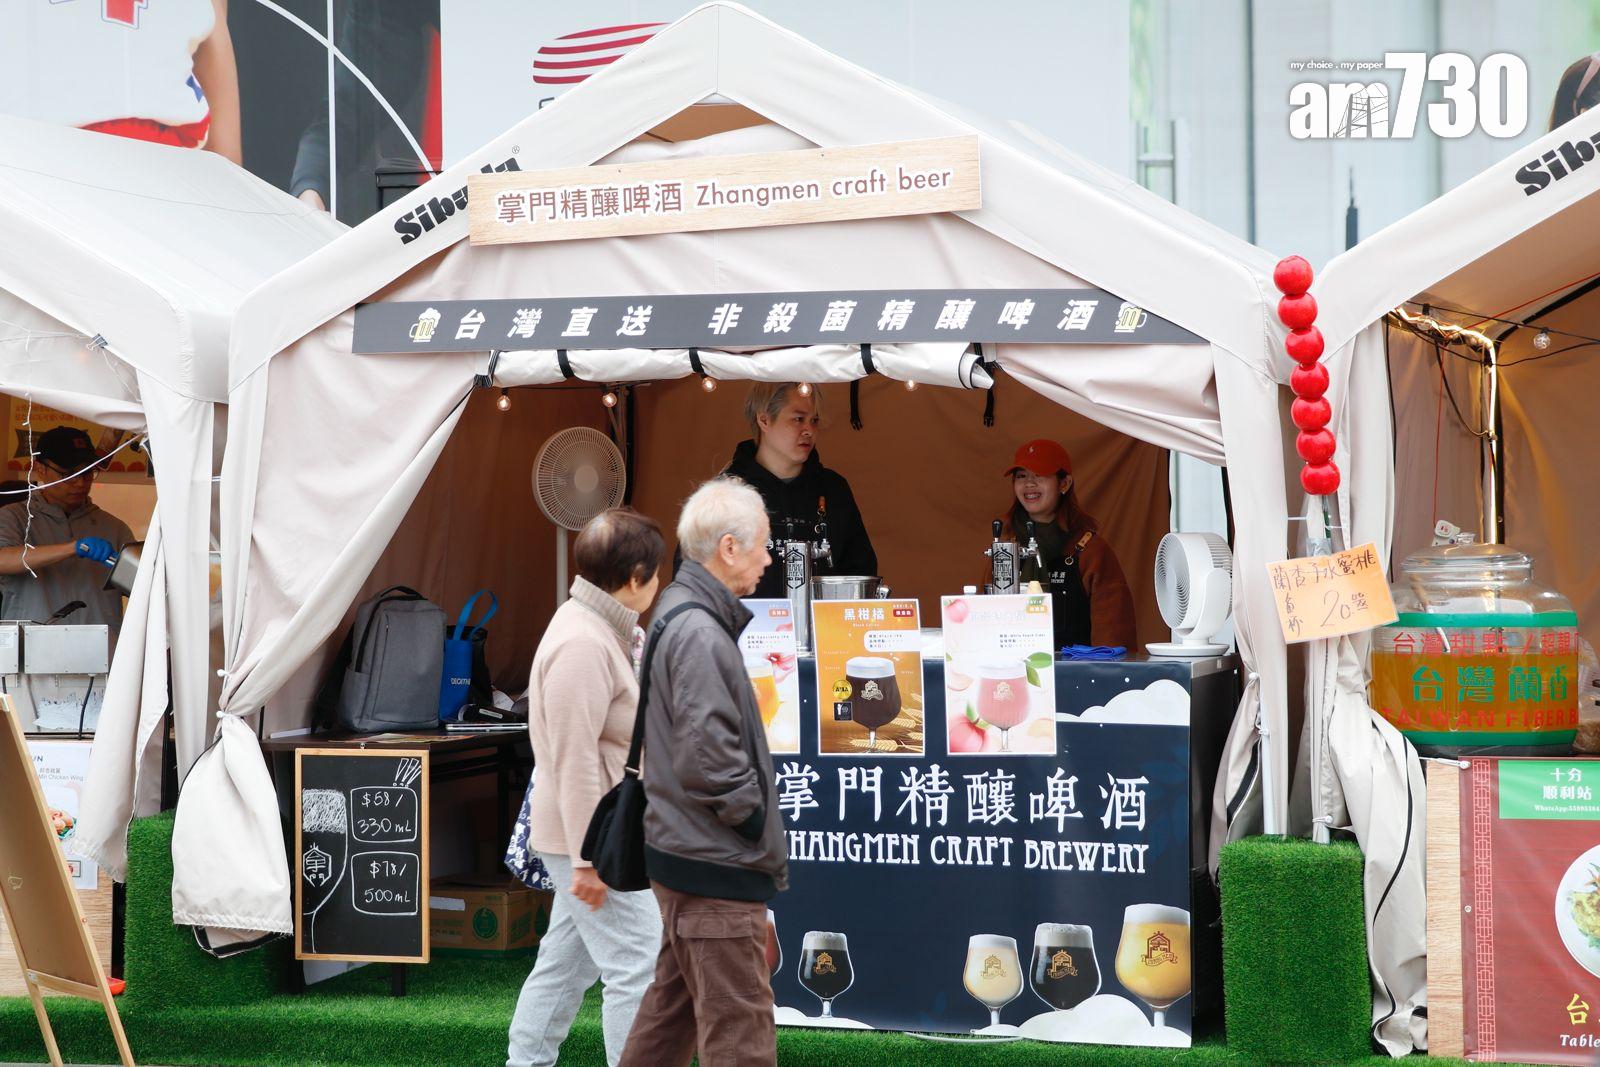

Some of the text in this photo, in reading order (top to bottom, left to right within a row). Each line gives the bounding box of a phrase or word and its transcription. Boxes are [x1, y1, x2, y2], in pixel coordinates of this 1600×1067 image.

[1515, 131, 1600, 196] Sib
[497, 167, 951, 223] 掌門精釀啤酒 Zhangmen craft beer
[454, 299, 1098, 340] 台灣直送 非殺菌精釀啤酒
[843, 607, 884, 621] 黑柑橘
[1393, 631, 1510, 658] 台灣甜點
[1412, 664, 1568, 703] 台灣蘭香
[1381, 706, 1495, 728] TAIWAN
[1550, 767, 1582, 783] 十分
[774, 761, 1150, 834] 掌門精釀啤酒
[1542, 785, 1593, 801] 順利站
[784, 830, 1150, 874] HANGMEN CRAFT BREWERY
[1567, 993, 1600, 1025] 台
[1559, 1034, 1600, 1048] Table
